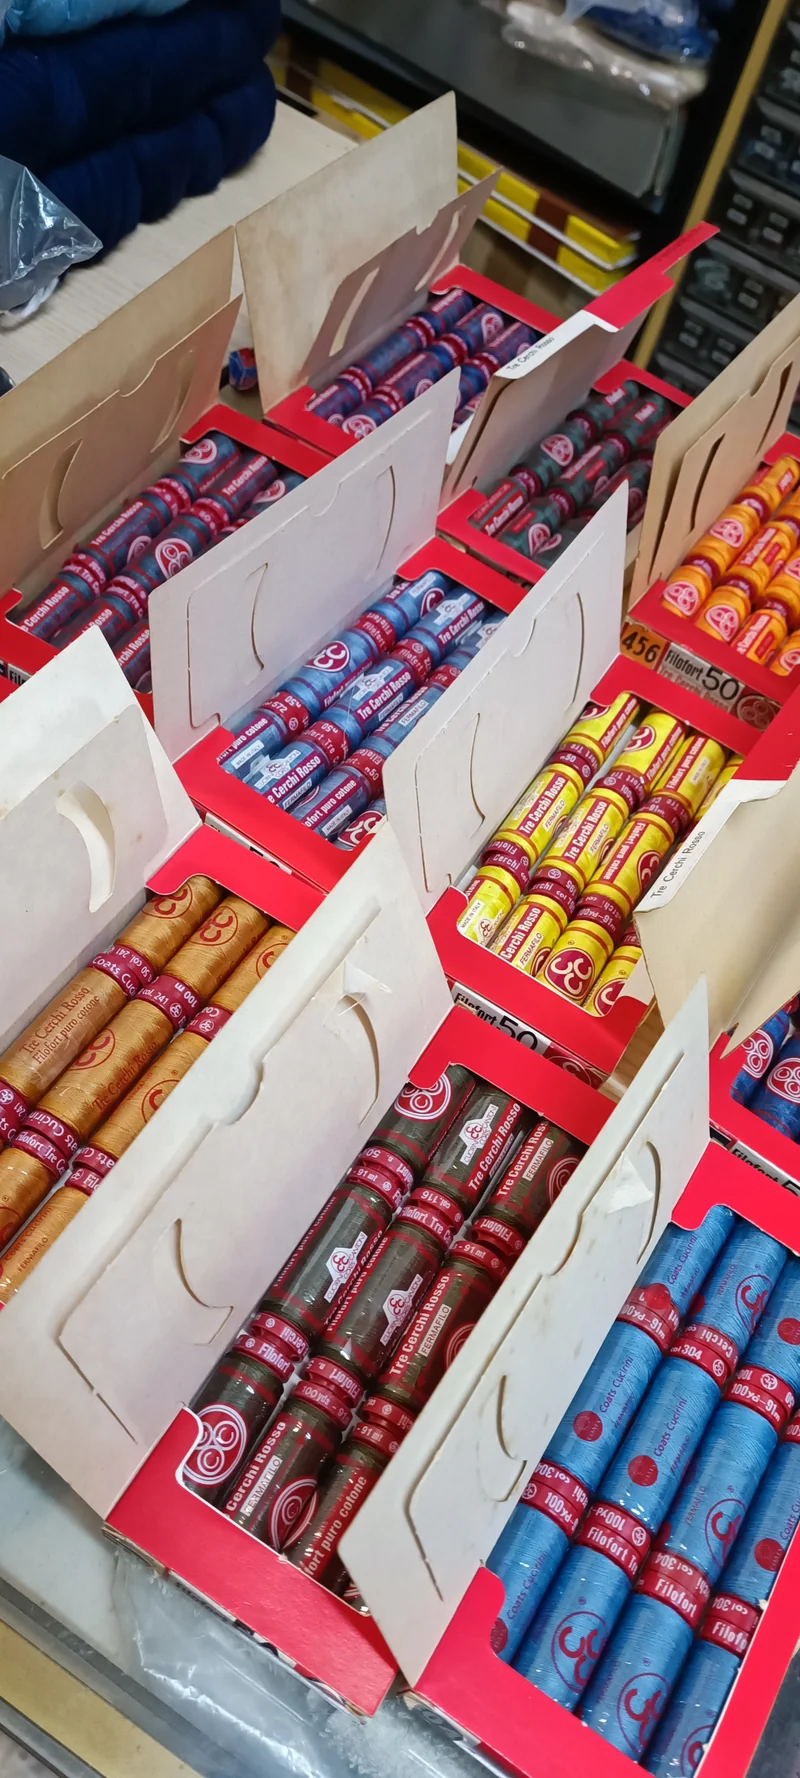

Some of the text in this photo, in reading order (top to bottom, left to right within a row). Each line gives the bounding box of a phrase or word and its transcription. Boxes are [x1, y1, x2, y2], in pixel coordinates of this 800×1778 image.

[23, 585, 70, 630] Cerchi Rosso
[439, 630, 452, 646] Tre
[449, 612, 471, 636] Cerchi
[622, 631, 661, 663] 456
[664, 649, 740, 701] Filofort 50
[357, 671, 412, 720] Tre Cerchi Rosso
[231, 717, 269, 751] puro cotone
[323, 738, 336, 755] Tre
[271, 769, 301, 804] Cerchi
[297, 754, 322, 779] Rosso
[321, 796, 338, 815] puro
[334, 780, 358, 802] cotone
[519, 815, 536, 834] Tre
[528, 792, 552, 823] Cerchi
[545, 776, 567, 800] Rosso
[544, 800, 566, 830] FERMAFILO
[563, 843, 580, 861] Tre
[573, 820, 596, 850] Cerchi
[590, 800, 608, 826] Rosso
[589, 823, 611, 854] FERMAFILO
[492, 852, 522, 871] Cerchi
[650, 830, 706, 899] Tre Cerchi Rosso
[501, 906, 542, 960] Cerchi Rosso
[519, 932, 544, 966] FERMAFILO
[92, 955, 121, 976] Coats
[154, 991, 170, 1005] 241
[19, 985, 91, 1056] Tre Cerchi Rosso
[31, 994, 101, 1066] Filofort puro cotone
[106, 1064, 136, 1096] Cerchi
[467, 1174, 486, 1194] Tre
[478, 1134, 505, 1182] Cerchi
[498, 1102, 522, 1141] Rosso
[524, 1139, 554, 1180] FERMAFILO
[496, 1176, 514, 1197] Tre
[506, 1140, 534, 1187] Cerchi
[428, 1216, 444, 1235] Tre
[17, 1236, 50, 1274] FERMAFILO
[350, 1268, 369, 1294] puro
[667, 1262, 684, 1286] Coats
[388, 1274, 450, 1377] Tre Cerchi Rosso
[419, 1306, 451, 1357] FERMAFILO
[257, 1342, 291, 1374] Filofort
[681, 1344, 703, 1360] 304
[700, 1328, 733, 1359] Cerchi
[599, 1355, 634, 1415] Coats Cucirini
[360, 1425, 372, 1437] 91
[653, 1398, 687, 1458] Coats Cucirini
[225, 1421, 287, 1512] Cerchi Rosso
[321, 1520, 344, 1552] puro
[339, 1475, 368, 1520] cotone
[779, 1513, 798, 1541] Coats
[586, 1526, 631, 1562] Filofort
[654, 1551, 678, 1571] 304
[507, 1591, 527, 1622] Coats
[654, 1577, 698, 1618] Filofort
